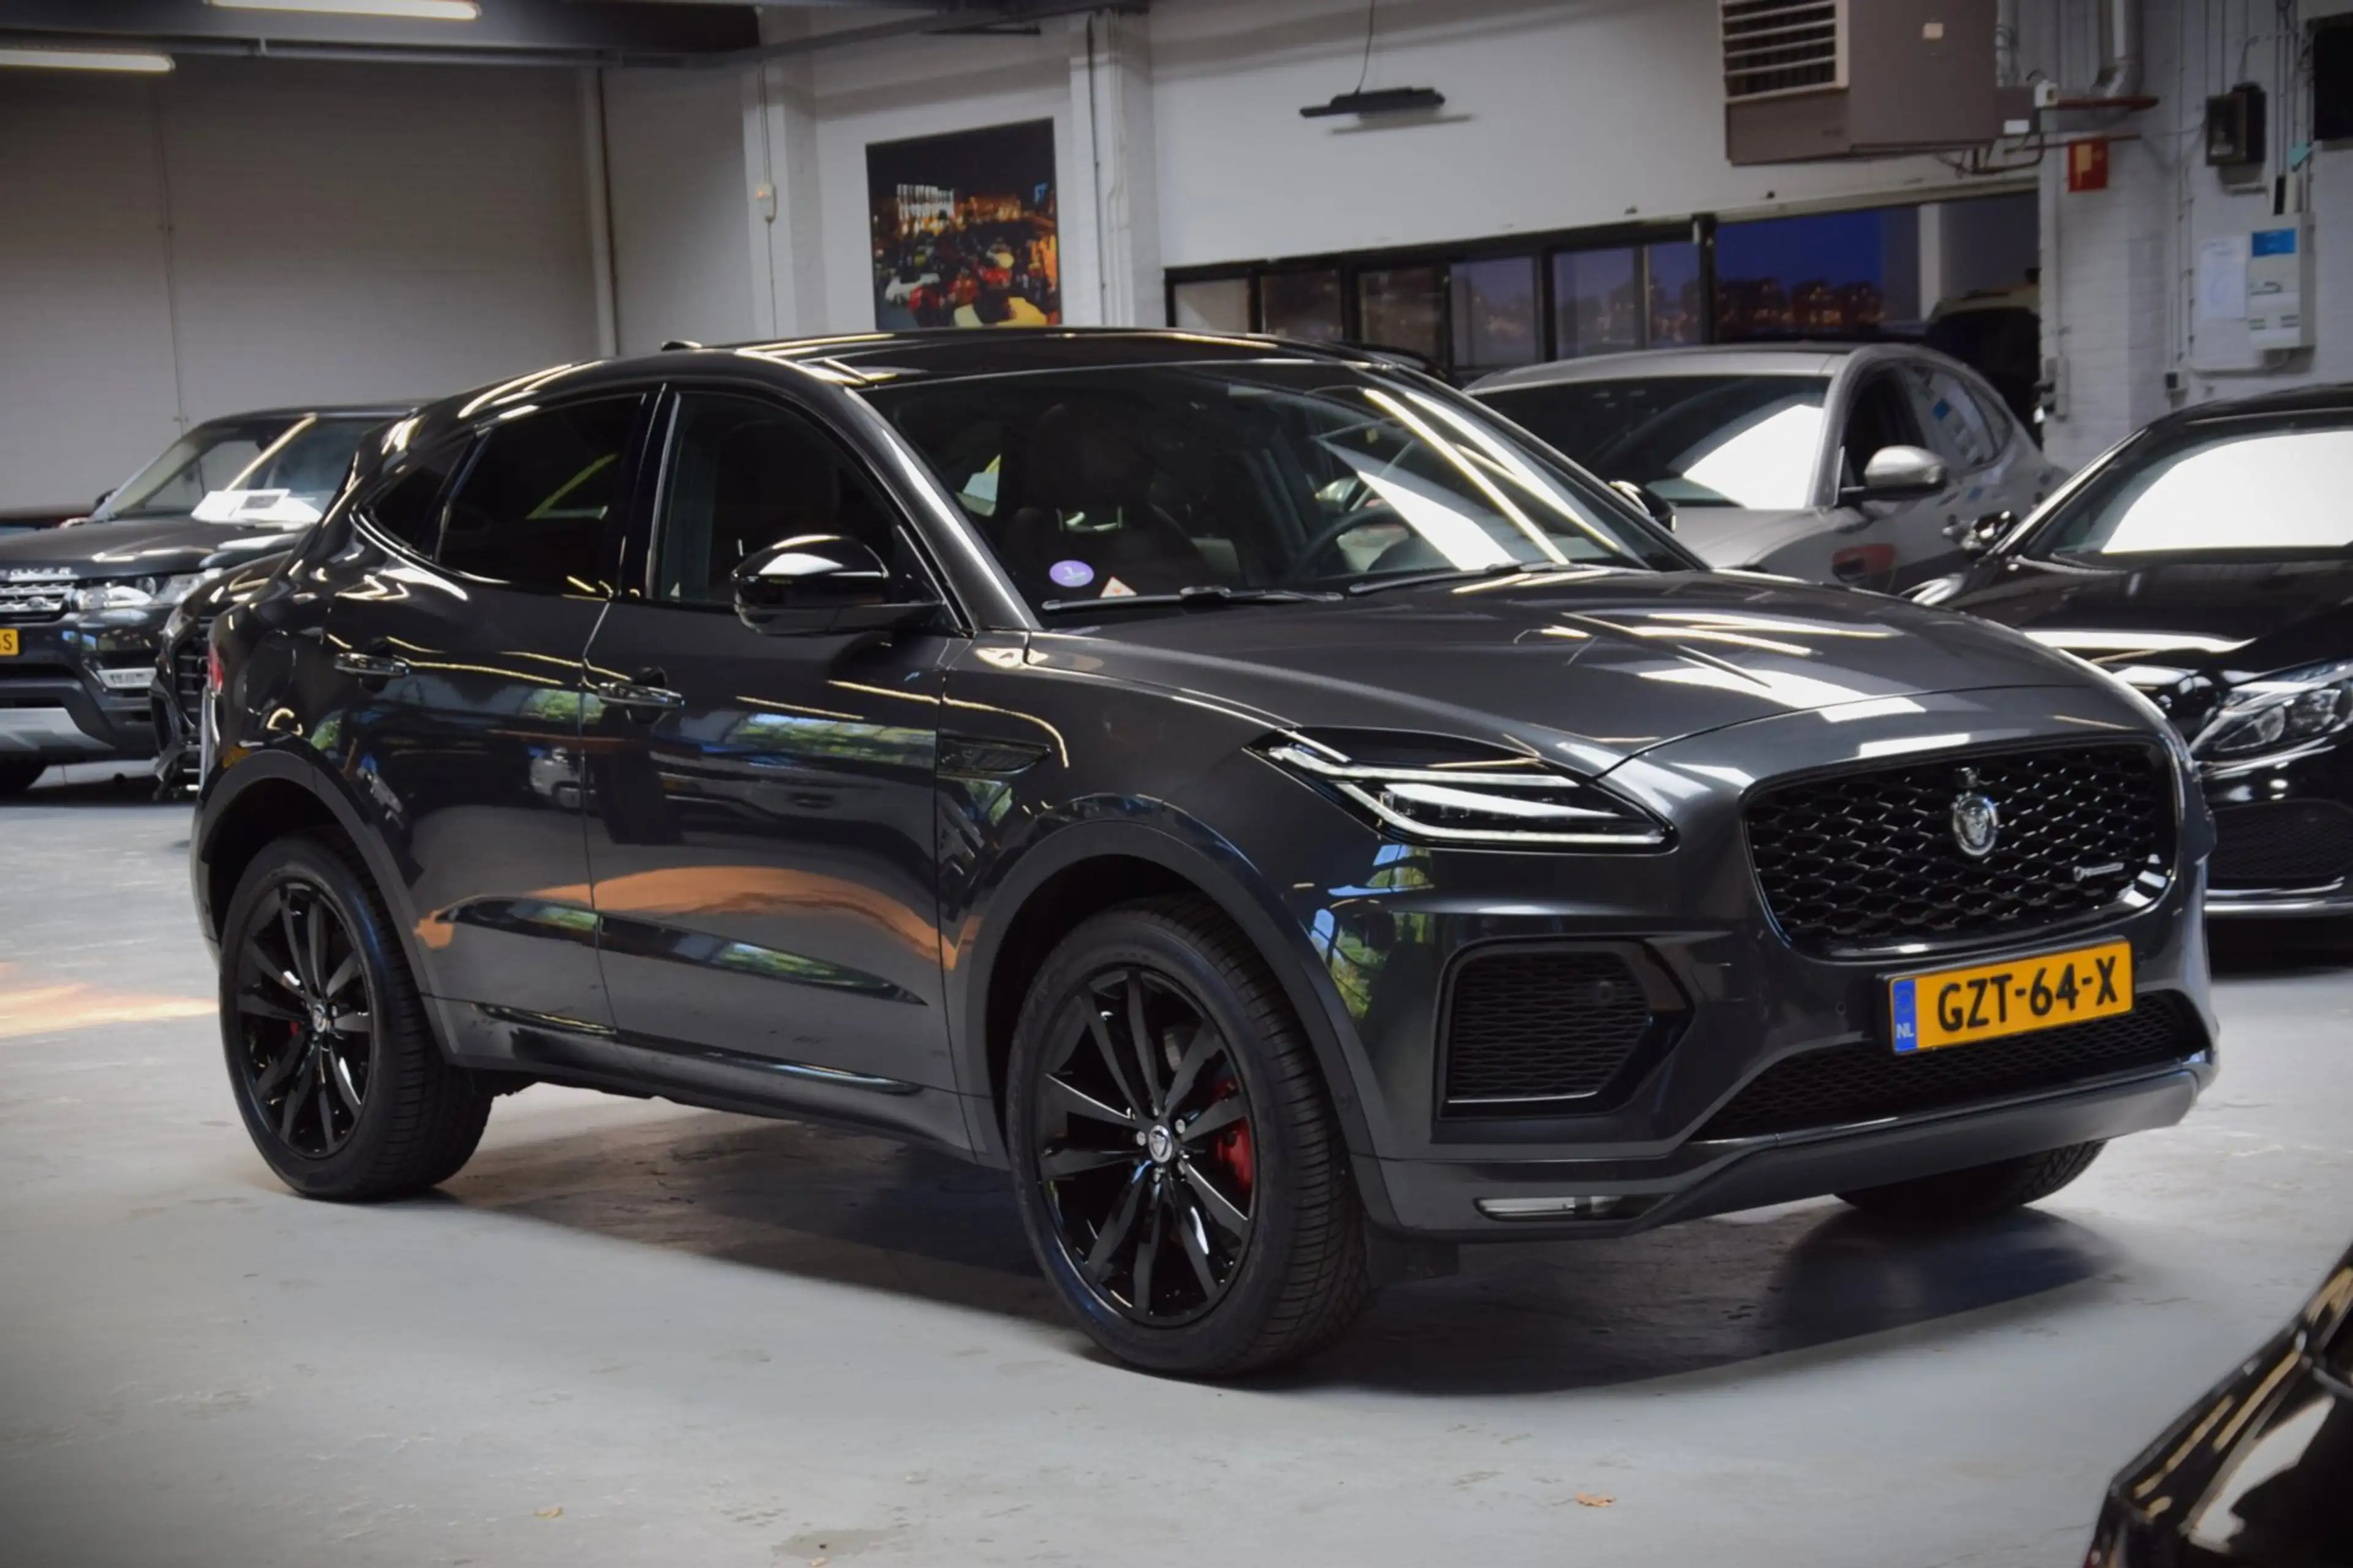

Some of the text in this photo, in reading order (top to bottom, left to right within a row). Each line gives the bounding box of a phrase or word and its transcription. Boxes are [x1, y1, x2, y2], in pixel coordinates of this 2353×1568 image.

[0, 633, 12, 651] S
[1938, 955, 2118, 1032] GZT-64-X
[1896, 1022, 1914, 1039] NL
